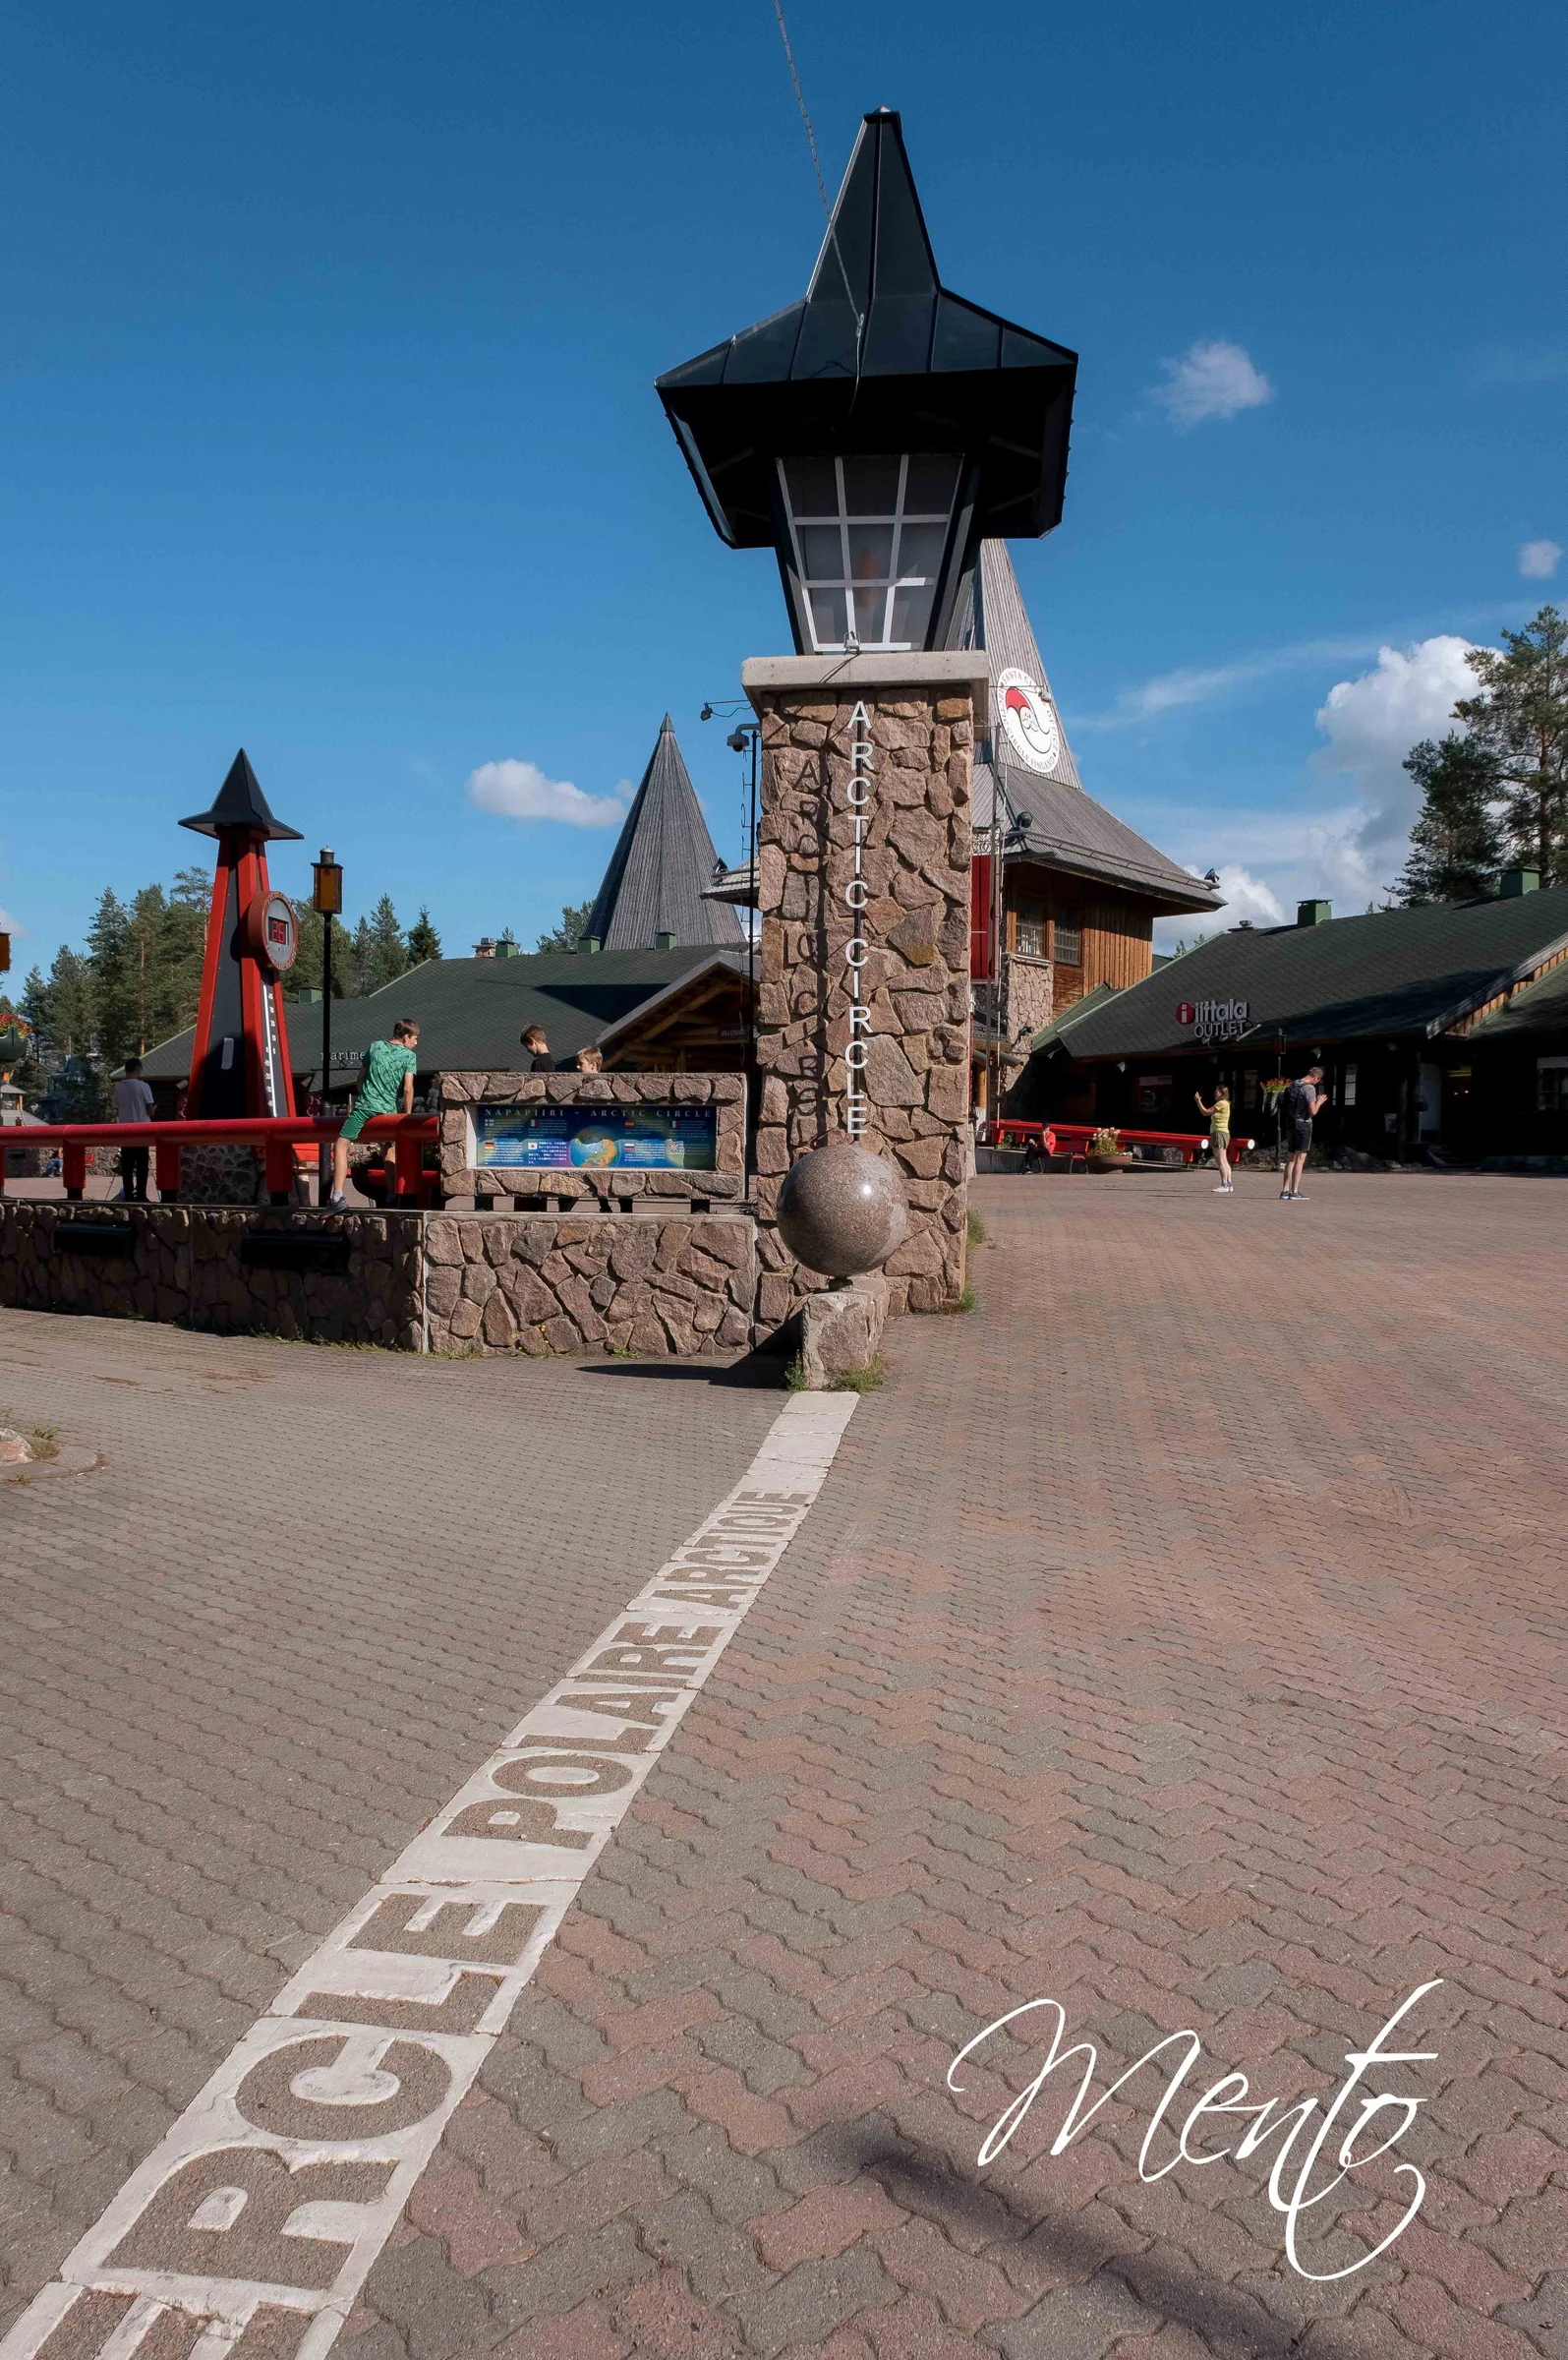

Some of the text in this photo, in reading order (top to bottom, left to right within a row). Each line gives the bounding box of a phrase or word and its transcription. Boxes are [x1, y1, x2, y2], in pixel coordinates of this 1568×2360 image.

[998, 688, 1056, 771] ARCTIC CIRCLE FINLAND
[1003, 671, 1023, 683] SANTA
[1046, 710, 1060, 752] OFFICE
[271, 920, 285, 943] 26
[844, 700, 876, 1135] ARCTIC CIRCLE
[1193, 1020, 1247, 1037] OUTLET
[320, 1050, 367, 1061] arime
[484, 1108, 712, 1118] NAPAPIIRI ARCTIC CIRCLE
[441, 1622, 726, 1851] POLAIRE
[651, 1491, 813, 1611] ARCTIQUE
